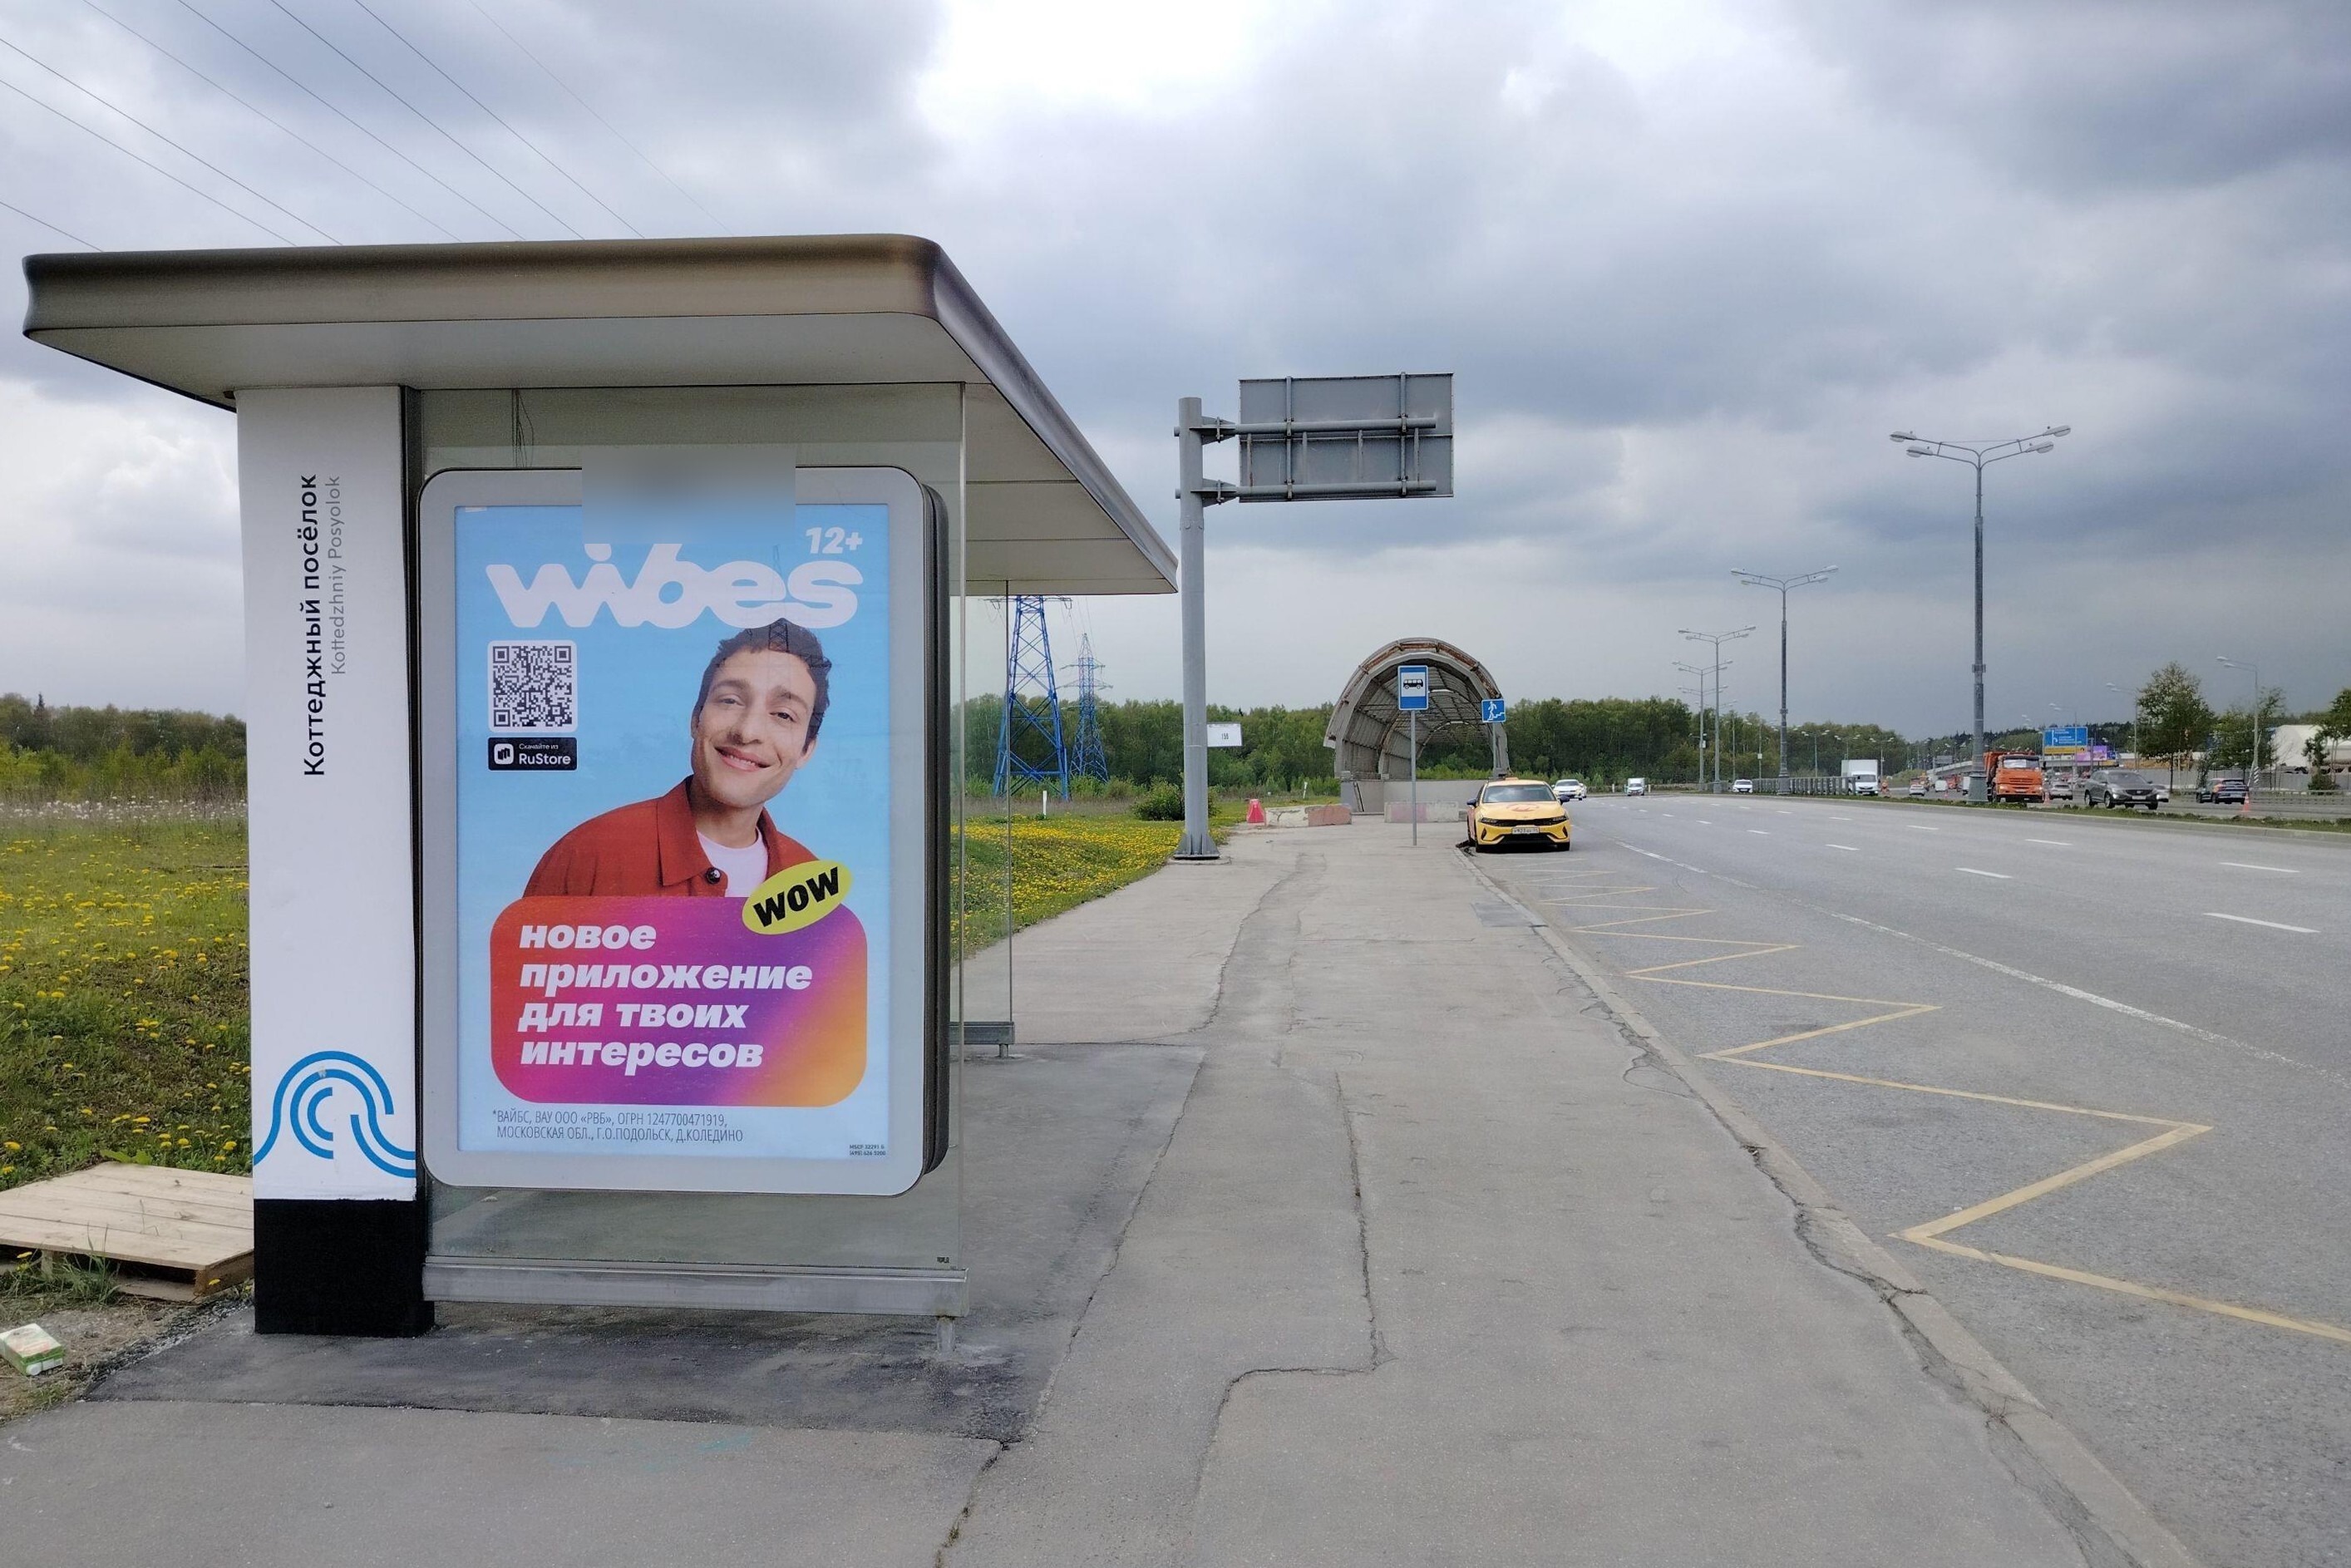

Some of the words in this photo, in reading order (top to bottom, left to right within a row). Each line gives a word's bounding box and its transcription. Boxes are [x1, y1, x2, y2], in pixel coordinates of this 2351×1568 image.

[297, 474, 320, 589] посёлок
[324, 476, 345, 560] Posyolok
[806, 526, 864, 555] 12+
[328, 565, 347, 674] Kottedzhniy
[299, 599, 326, 776] Коттеджный
[519, 752, 572, 765] RuStore
[753, 866, 840, 928] WOW
[519, 925, 657, 950] новое
[519, 964, 813, 998] приложение
[517, 1003, 605, 1033] для
[615, 1003, 750, 1029] твоих
[519, 1041, 764, 1077] интересов
[497, 1126, 564, 1139] МОСКОВСКАЯ
[567, 1127, 594, 1141] ОБЛ.,
[597, 1127, 673, 1142] Г.О.ПОДОЛЬСК,
[676, 1128, 743, 1143] Д.КОЛЕДИНО
[535, 1111, 553, 1123] ВАУ
[554, 1111, 578, 1124] ООО
[580, 1112, 614, 1127] «РВБ»,
[618, 1112, 643, 1125] ОГРН
[647, 1112, 727, 1127] 1247700471919,
